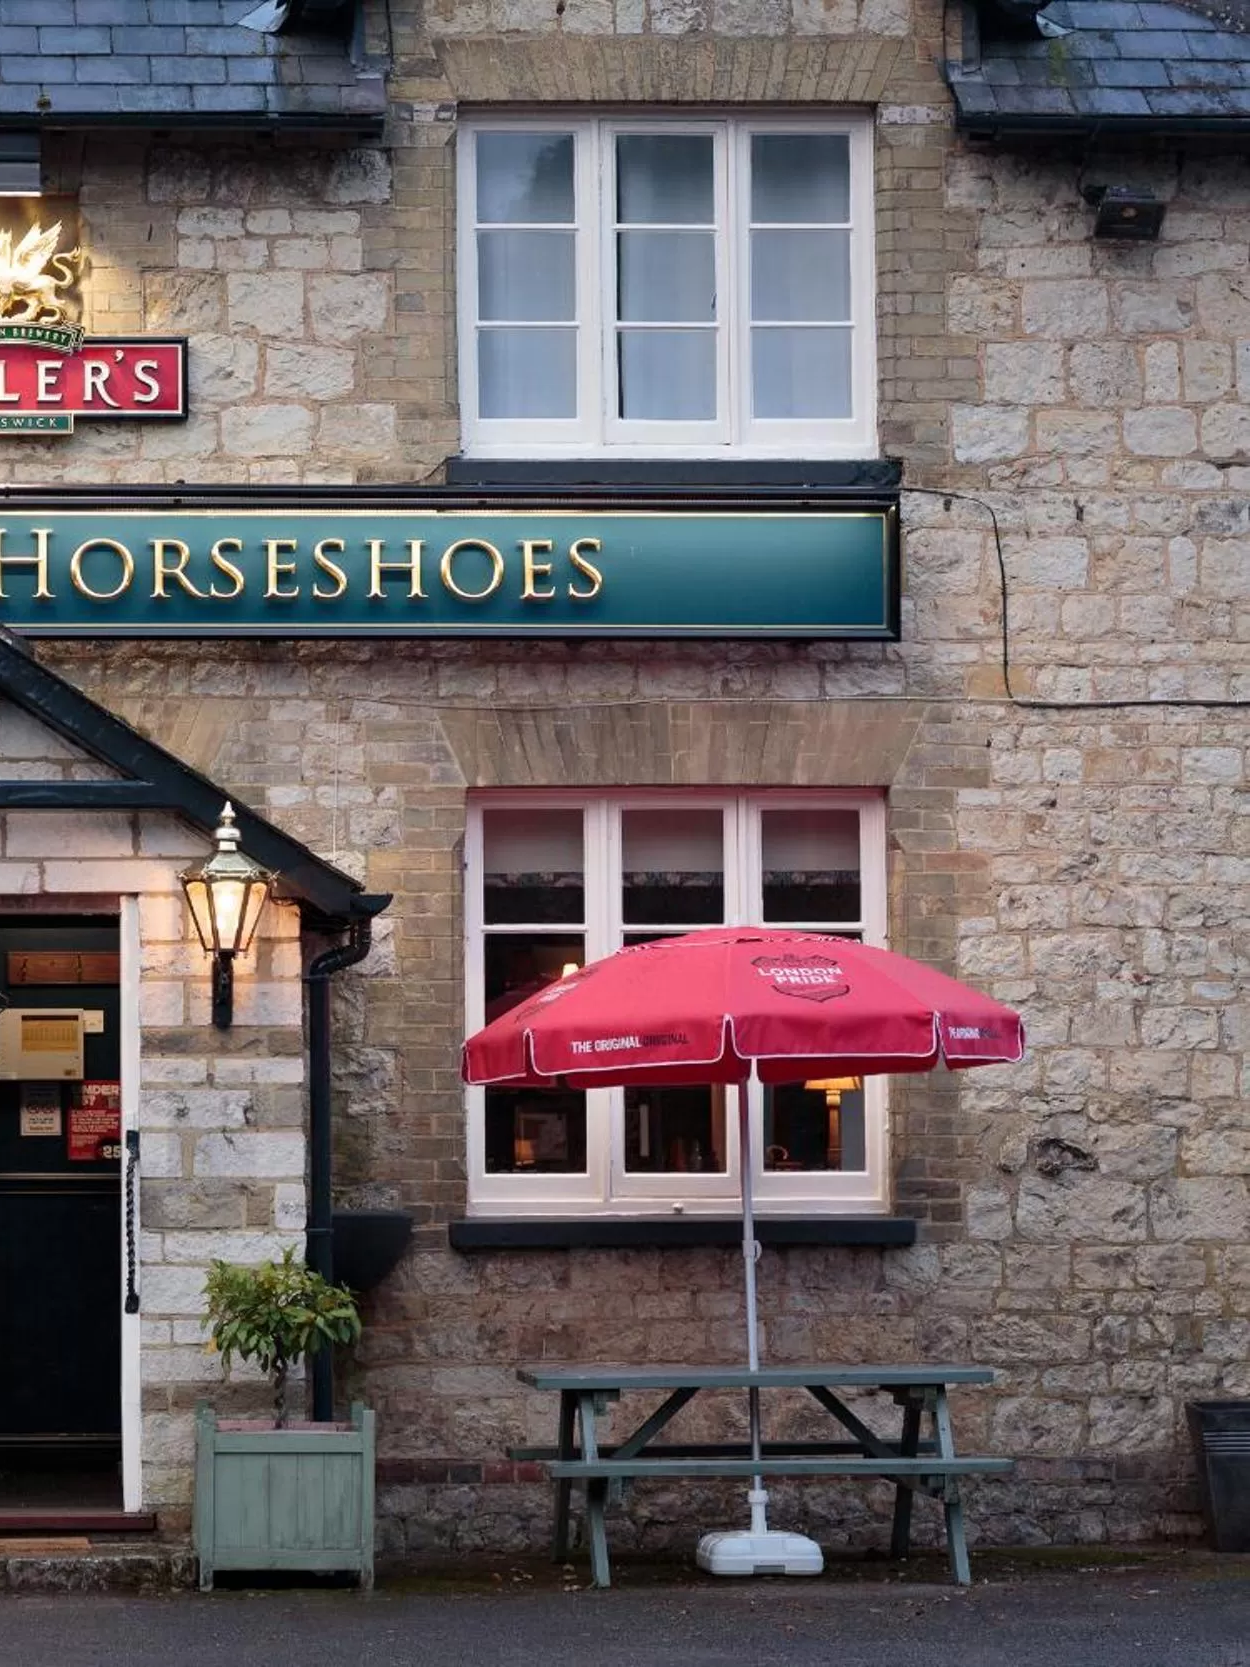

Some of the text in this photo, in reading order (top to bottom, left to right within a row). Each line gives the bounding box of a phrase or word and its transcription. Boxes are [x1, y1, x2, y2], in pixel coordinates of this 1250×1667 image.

[12, 328, 68, 343] BREWERY
[757, 967, 843, 976] LONDON
[774, 976, 839, 985] PRIDE
[570, 1040, 593, 1054] THE
[594, 1036, 642, 1052] ORIGINAL
